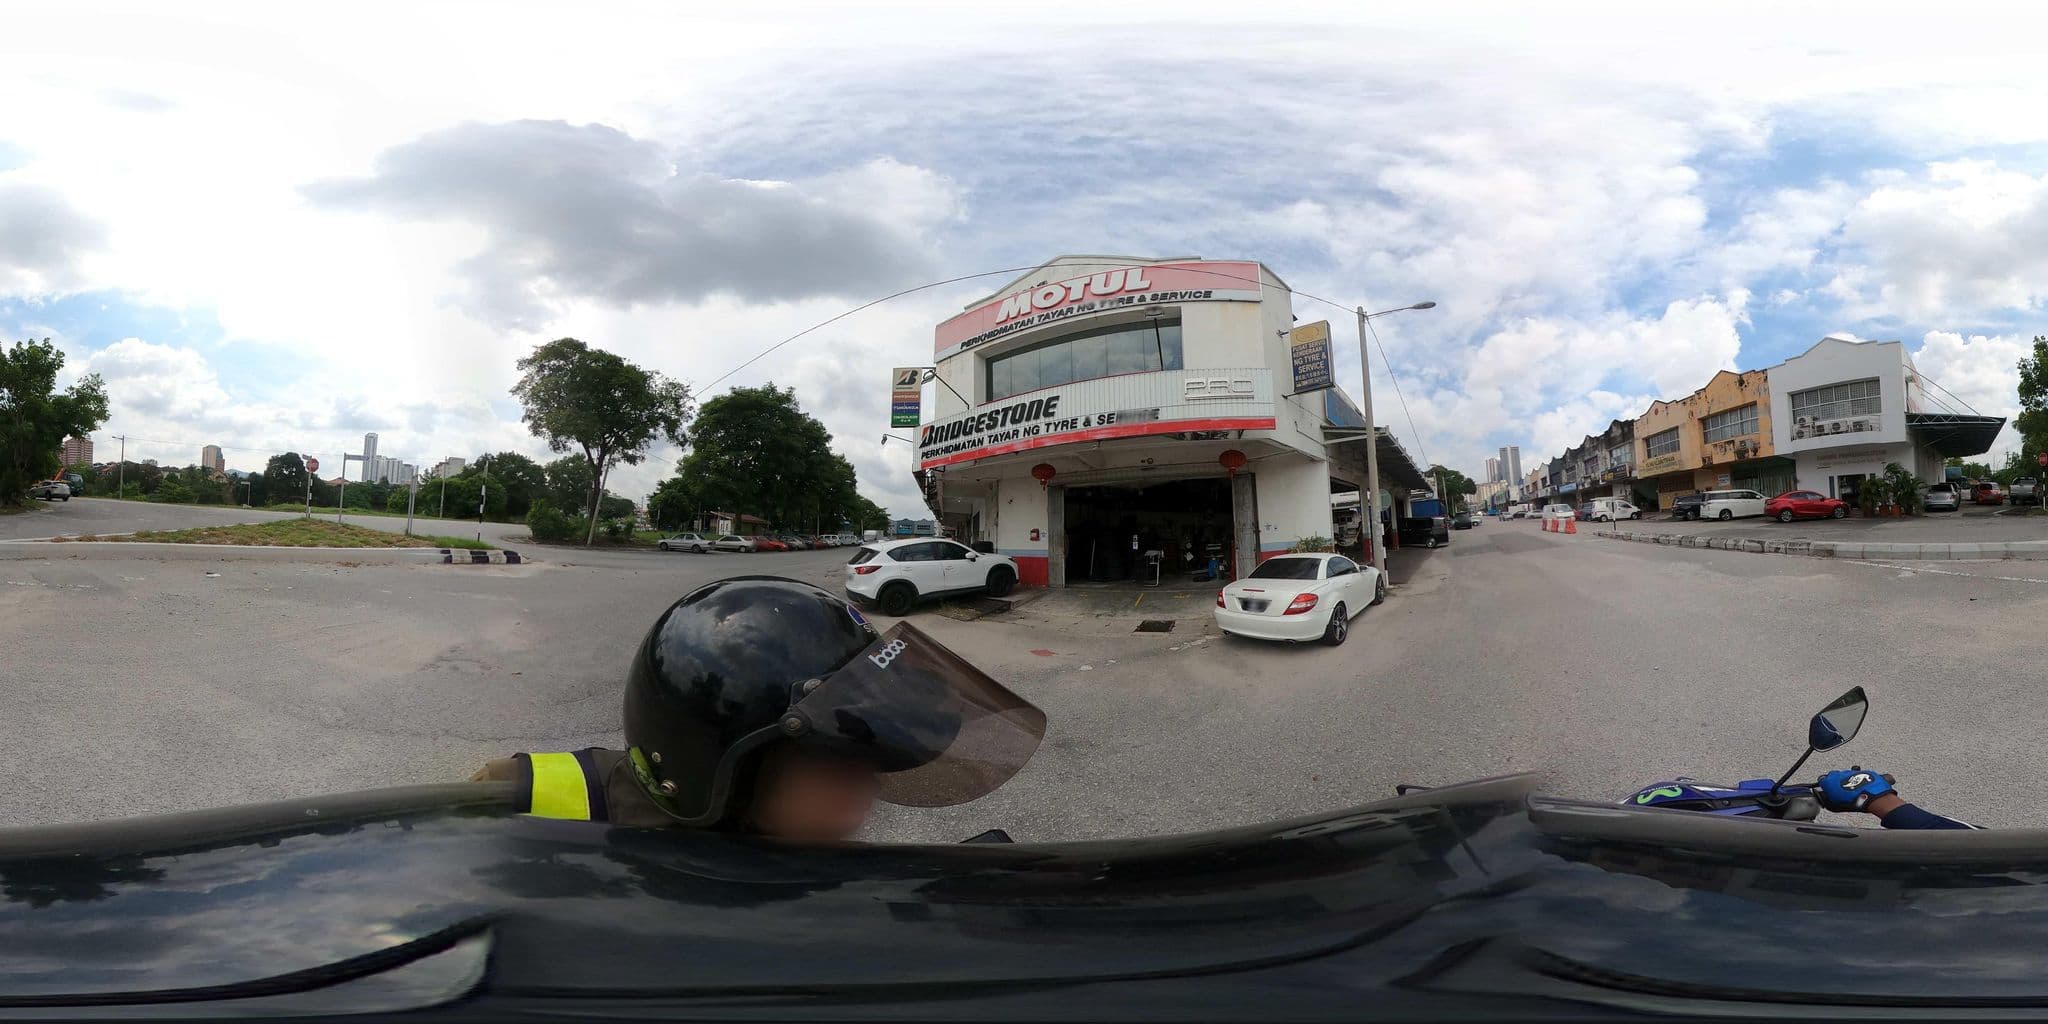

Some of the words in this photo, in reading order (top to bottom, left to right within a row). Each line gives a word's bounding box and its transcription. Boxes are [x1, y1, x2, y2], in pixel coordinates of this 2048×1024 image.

[960, 316, 1035, 349] PERKHIDMATAN
[1037, 307, 1074, 323] TAYAR
[1076, 301, 1095, 313] NG
[1137, 294, 1147, 303] &
[1150, 290, 1213, 301] SERVICE
[996, 267, 1152, 324] MOTUL
[1298, 360, 1325, 374] SERVICE
[1304, 353, 1321, 363] TYRE
[919, 395, 1060, 449] BRIDGESTONE
[921, 437, 984, 459] PERKHIDMATAN
[988, 429, 1019, 444] TAYAR
[1023, 425, 1040, 437] NG
[1045, 418, 1078, 433] TYRE
[1083, 416, 1092, 427] &
